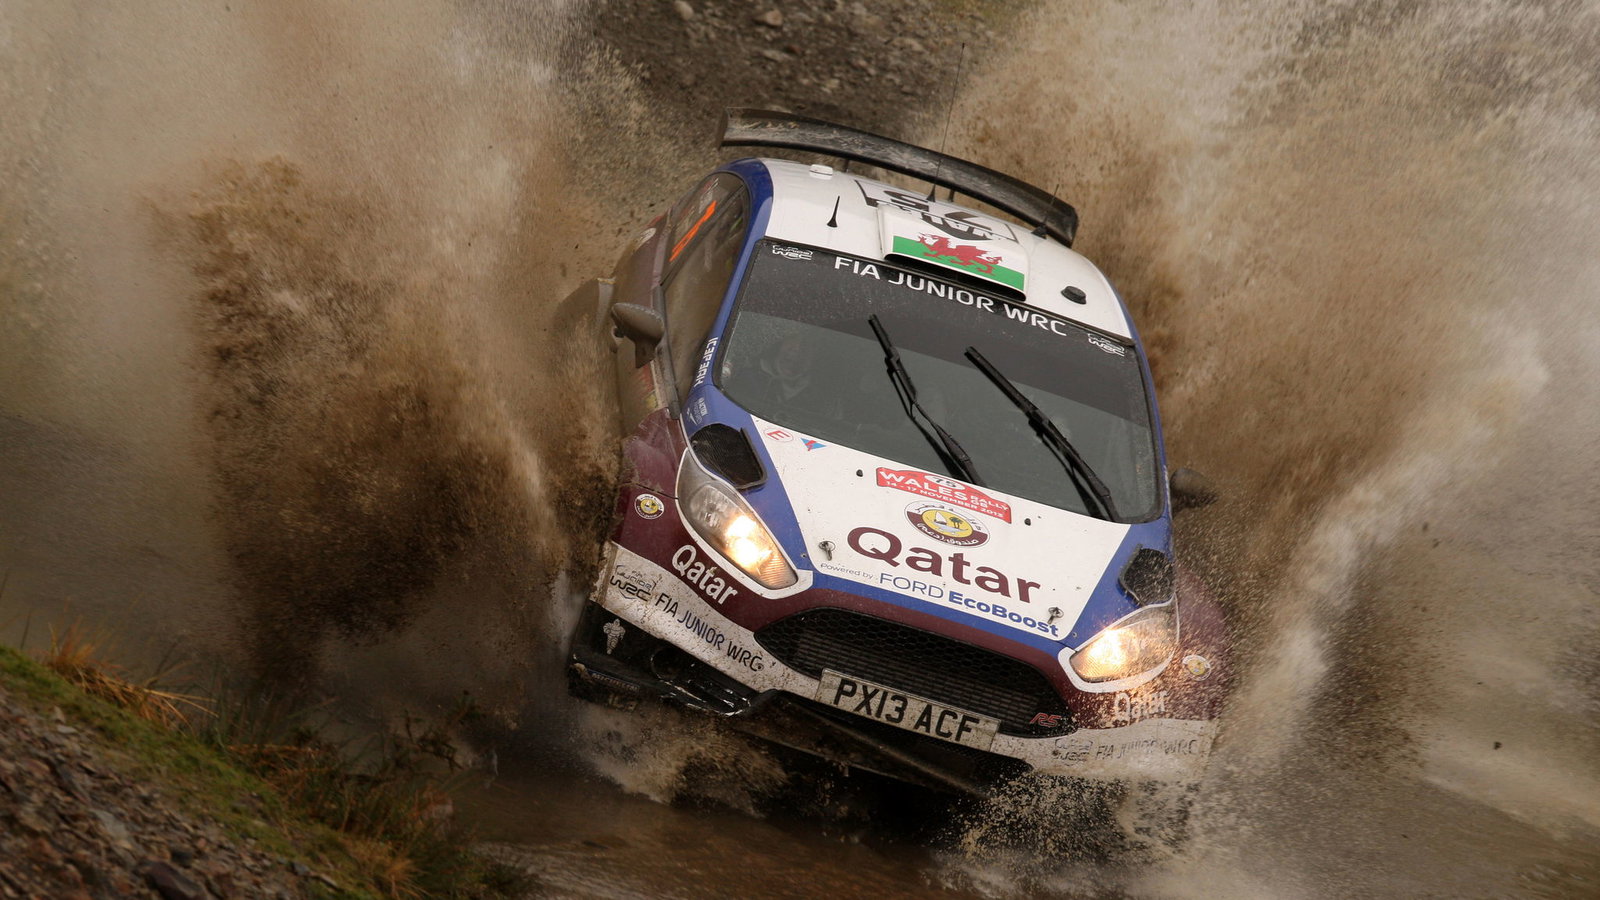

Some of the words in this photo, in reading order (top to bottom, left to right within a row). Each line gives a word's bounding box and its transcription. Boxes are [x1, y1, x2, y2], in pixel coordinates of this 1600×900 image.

[834, 256, 880, 280] FIA
[888, 272, 994, 313] JUNIOR
[1003, 303, 1067, 337] WRC
[766, 430, 790, 441] E
[879, 471, 968, 501] WALES
[919, 490, 978, 509] NOVEMBER
[970, 495, 1009, 511] RALLY
[671, 544, 739, 605] Qatar
[847, 526, 1041, 604] Qatar
[610, 575, 652, 602] WRC
[820, 562, 861, 576] Powered
[862, 572, 874, 580] by
[879, 572, 944, 599] FORD
[948, 590, 1059, 638] EcoBoost
[655, 593, 677, 618] FIA
[677, 610, 725, 651] JUNIOR
[728, 641, 762, 672] WRC
[833, 678, 908, 724] PX13
[913, 704, 980, 742] ACF
[1029, 712, 1062, 728] RS
